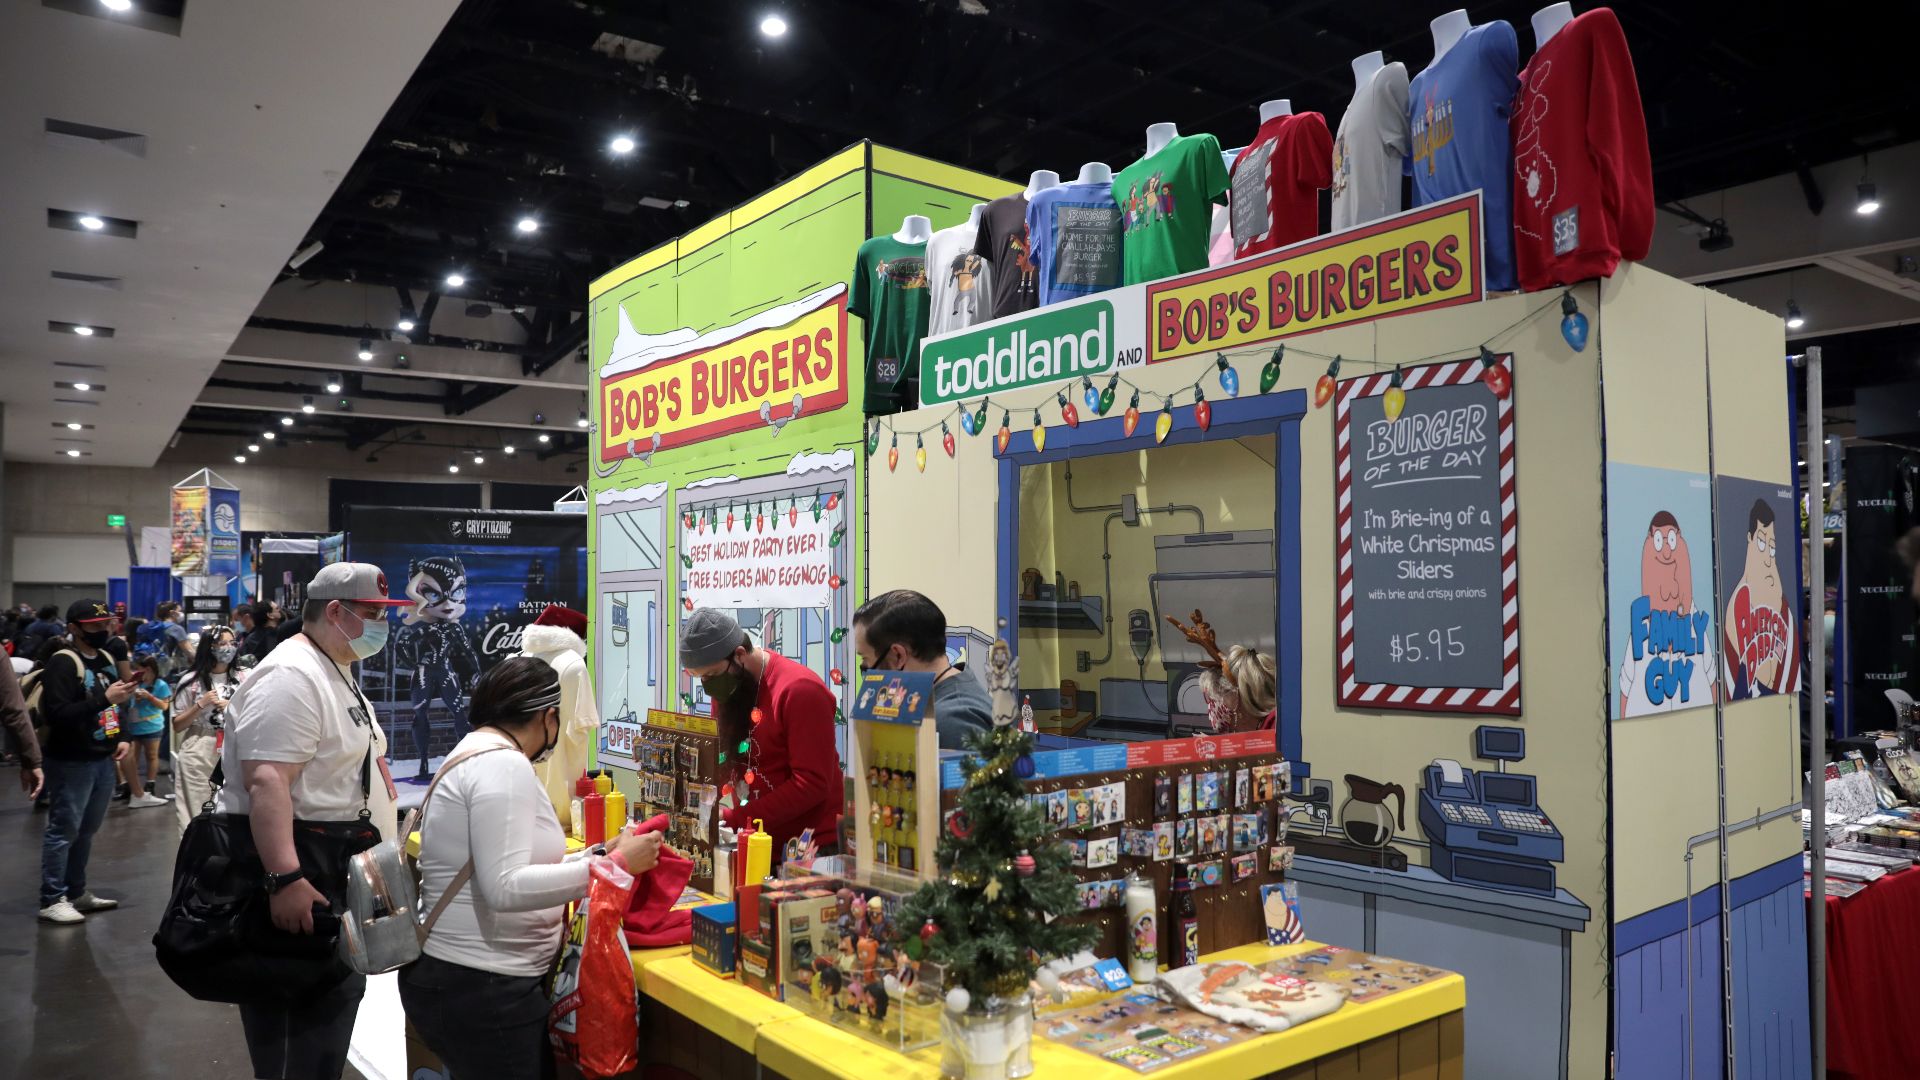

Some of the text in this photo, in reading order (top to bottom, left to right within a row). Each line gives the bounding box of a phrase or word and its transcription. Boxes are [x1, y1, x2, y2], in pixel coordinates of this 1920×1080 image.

[1068, 209, 1112, 221] BURGER
[1554, 214, 1577, 245] $35
[1062, 232, 1115, 243] HOME FOR THE
[1074, 252, 1102, 261] BURGER
[1158, 234, 1464, 353] BOB'S BURGERS
[935, 310, 1143, 398] toddland AND
[610, 326, 833, 437] BOB'S BURGERS
[878, 361, 896, 378] $28
[1366, 404, 1487, 461] BURGER
[1364, 445, 1487, 482] OF THE DAY
[466, 519, 511, 534] CRYPTOZOIC
[1363, 505, 1492, 531] I'm Brie-ing of a
[690, 543, 711, 563] BEST
[713, 540, 750, 560] HOLIDAY
[753, 537, 784, 558] PARTY
[787, 533, 817, 555] EVER
[1360, 534, 1495, 557] White Chrispmas
[688, 563, 828, 589] FREE SLIDERS AND EGGNOG
[1397, 560, 1454, 580] Sliders
[518, 601, 567, 609] BATMAN
[1368, 587, 1487, 601] with brie and crispy onions
[1631, 595, 1709, 661] FAMILY
[1734, 585, 1788, 660] AMERICAN
[1390, 626, 1465, 662] $5.95
[1746, 634, 1776, 688] DAD!
[1645, 657, 1694, 706] GUY
